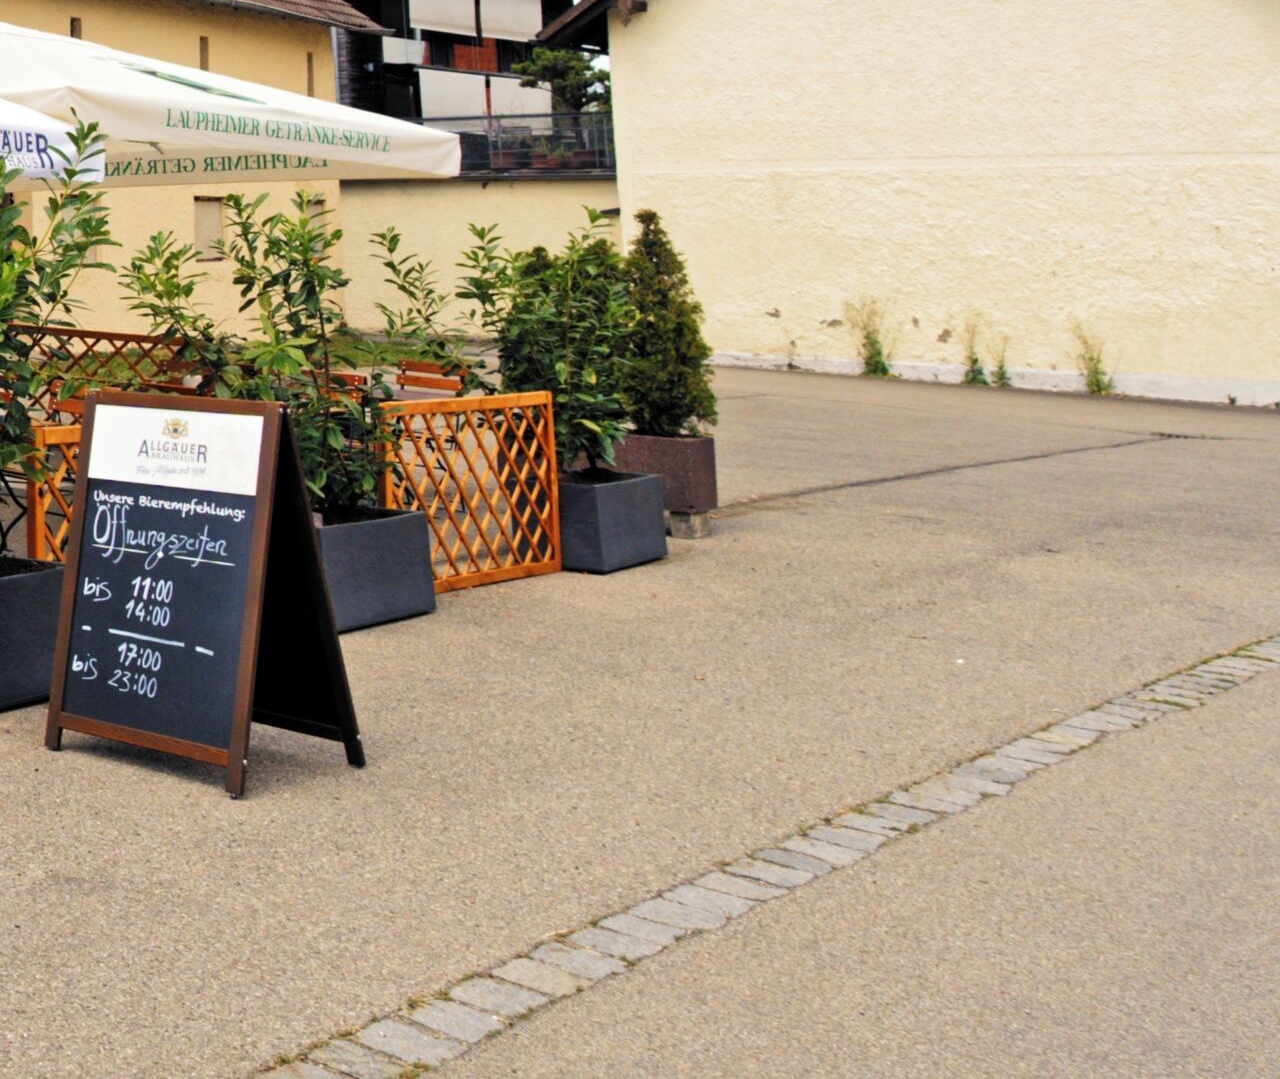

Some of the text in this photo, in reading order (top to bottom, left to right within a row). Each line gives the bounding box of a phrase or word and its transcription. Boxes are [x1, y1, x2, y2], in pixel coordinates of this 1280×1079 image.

[165, 108, 393, 153] LAUPHEIMER GETRÄNKE-SERVICE
[94, 489, 246, 522] Unsere Bierempfehlung:
[93, 503, 228, 570] Öffnungszeiten
[83, 576, 173, 603] bis 11:00
[125, 599, 170, 627] 14:00
[117, 642, 162, 671] 17:00
[72, 653, 158, 698] bis 23:00
